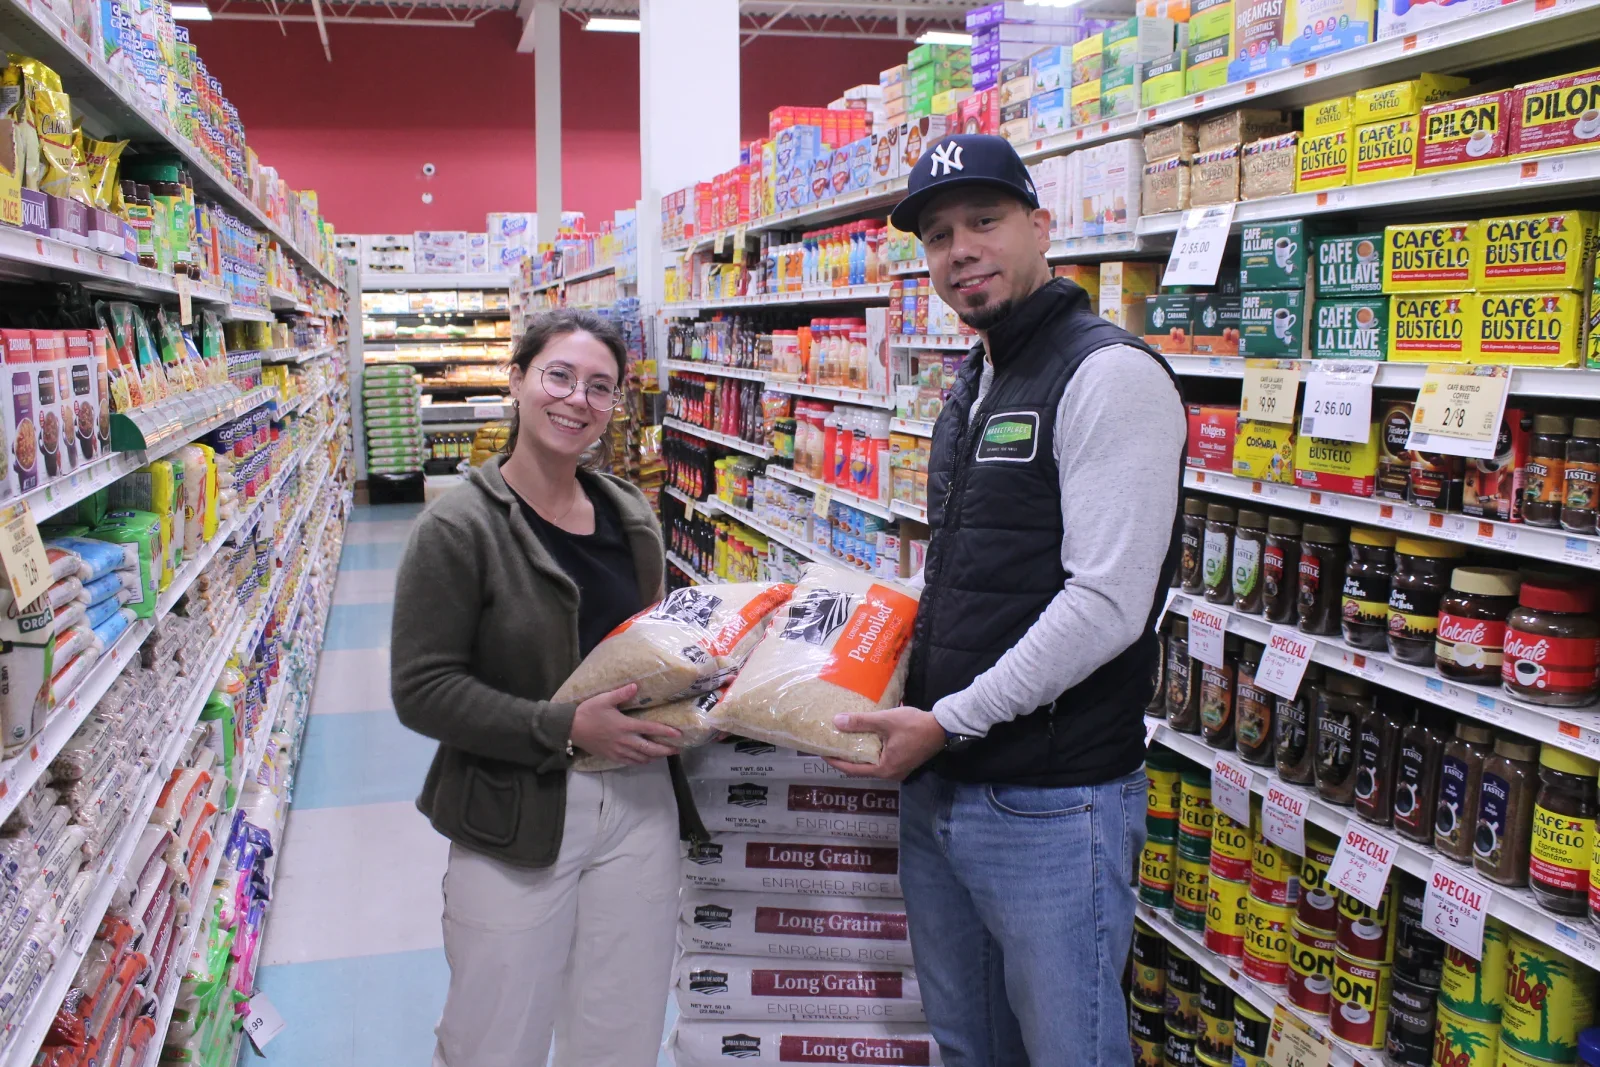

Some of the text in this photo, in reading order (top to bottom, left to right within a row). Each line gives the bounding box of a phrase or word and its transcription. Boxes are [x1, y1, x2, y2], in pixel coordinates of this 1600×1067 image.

[1237, 0, 1282, 29] BREAKFAST
[1195, 48, 1223, 63] GREEN TEA
[1149, 63, 1173, 77] GREEN TEA
[1369, 98, 1400, 112] BUSTELO
[1315, 110, 1342, 126] BUSTELO
[1428, 105, 1496, 141] PILON
[1301, 147, 1348, 171] BUSTELO
[1357, 136, 1413, 161] BUSTELO
[1251, 155, 1291, 173] SUPREMO
[2, 200, 19, 221] RICE
[22, 201, 47, 230] ROLINA
[1243, 228, 1261, 241] CAFE
[1243, 238, 1273, 251] LA LLAVE
[1180, 241, 1210, 254] 2/$5.00
[1320, 242, 1353, 265] CAFE
[1486, 238, 1567, 265] BUSTELO
[1392, 247, 1470, 270] BUSTELO
[1320, 262, 1380, 285] LA LLAVE
[1243, 297, 1260, 308] CAFE
[1242, 308, 1272, 320] LA LLAVE
[1318, 307, 1352, 328] CAFE
[1318, 329, 1335, 349] LA
[1338, 328, 1380, 349] LLAVE
[1396, 319, 1463, 339] BUSTELO
[1481, 318, 1561, 340] BUSTELO
[1452, 392, 1470, 400] COFFEE
[1459, 384, 1480, 392] BUSTELO
[1259, 396, 1276, 413] $9.99
[1314, 400, 1352, 416] 2/$6.00
[1200, 423, 1226, 438] Folgers
[1388, 424, 1408, 436] Taster's
[1309, 447, 1352, 464] BUSTELO
[847, 612, 867, 640] LONG GRAIN
[1192, 609, 1222, 630] SPECIAL
[1439, 615, 1487, 644] Colcafé
[848, 604, 894, 663] Parboiled
[870, 615, 904, 664] ENRICHED RICE
[1271, 635, 1307, 659] SPECIAL
[1504, 630, 1550, 661] Colcafé
[1, 666, 9, 695] USE TO
[1319, 717, 1351, 741] TASTLE
[1215, 761, 1247, 789] SPECIAL
[811, 788, 899, 811] Long Gra
[1483, 782, 1505, 800] TASTLE
[1267, 788, 1302, 816] SPECIAL
[796, 817, 879, 833] ENRICHED
[768, 846, 872, 867] Long Grain
[1346, 831, 1390, 865] SPECIAL
[1538, 841, 1567, 855] Espresso
[1349, 858, 1364, 870] SALE
[762, 878, 890, 893] ENRICHED RICE
[1432, 872, 1482, 912] SPECIAL
[1437, 902, 1454, 915] SALE
[777, 912, 882, 934] Long Grain
[768, 944, 896, 961] ENRICHED RICE
[1350, 966, 1376, 978] COFFEE
[774, 974, 877, 994] Long Grain
[767, 1003, 894, 1016] ENRICHED RICE
[801, 1040, 904, 1061] Long Grain
[1169, 1035, 1191, 1051] Chock
